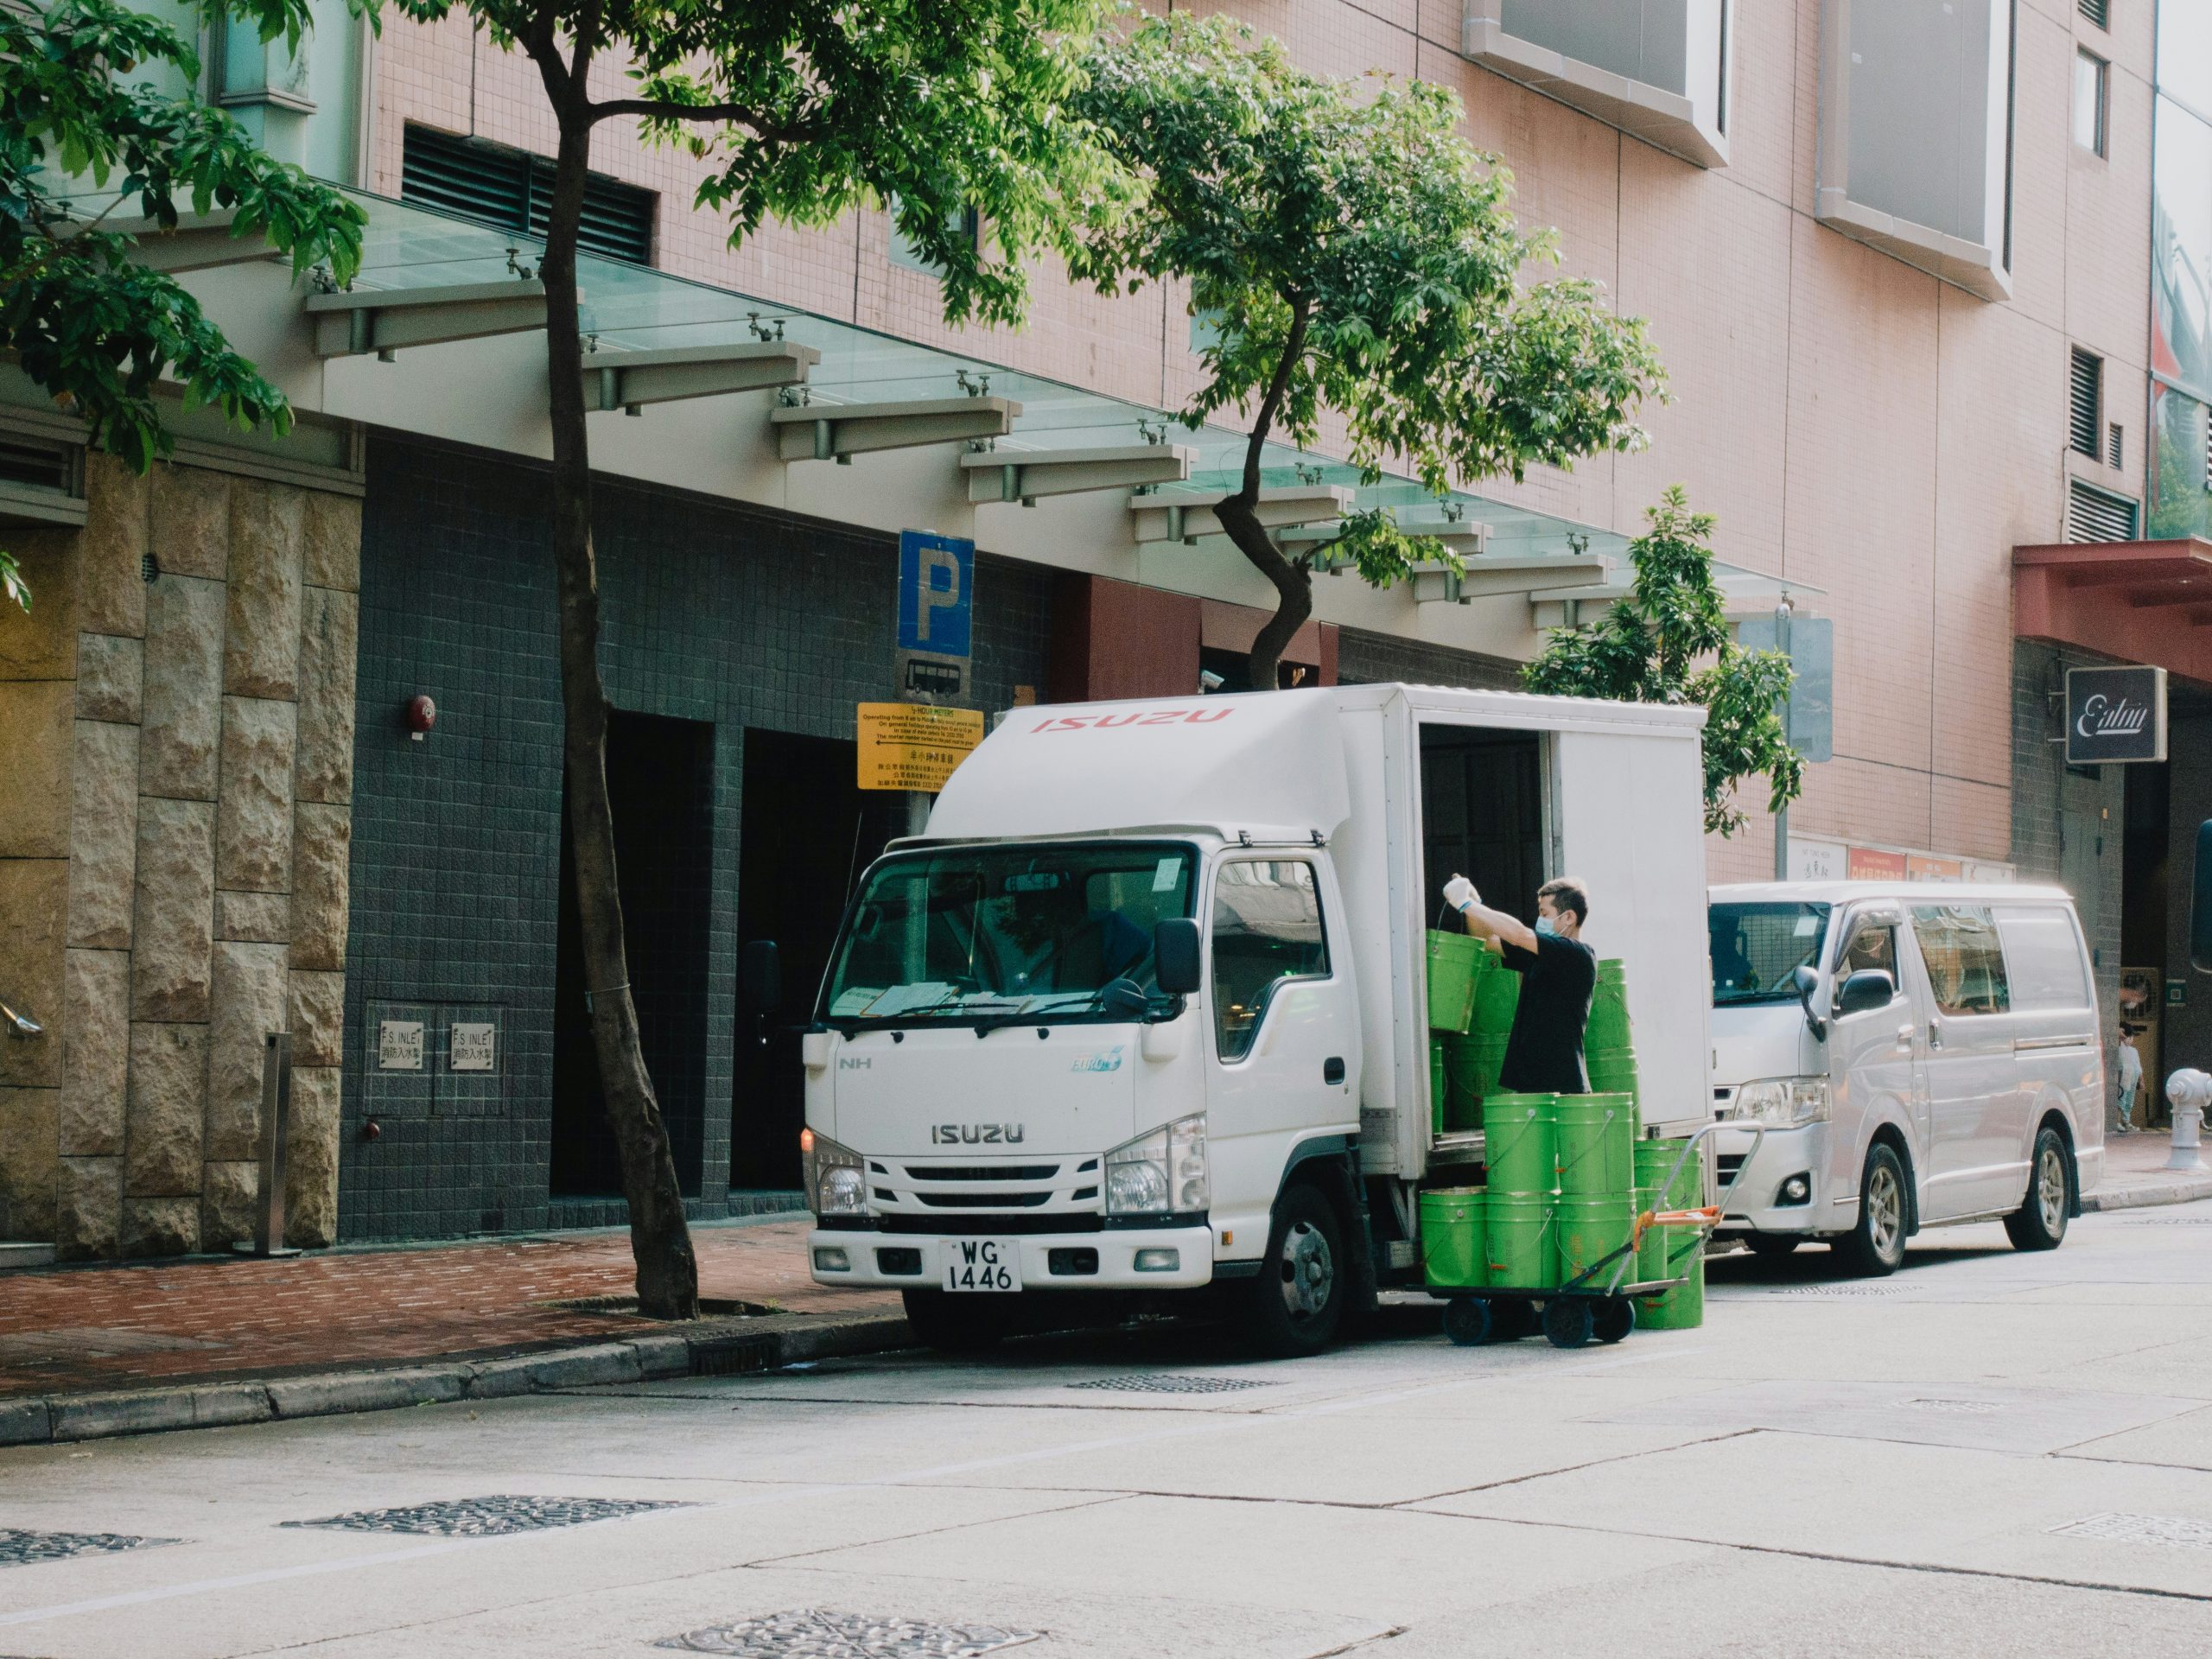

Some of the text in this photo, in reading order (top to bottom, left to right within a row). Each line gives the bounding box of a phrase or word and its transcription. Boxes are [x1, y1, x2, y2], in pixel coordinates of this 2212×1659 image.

[917, 547, 960, 641] P
[1029, 709, 1236, 734] ISUZU
[840, 1058, 872, 1070] NH
[931, 1123, 1025, 1144] ISUZU
[961, 1241, 998, 1264] WG
[950, 1266, 1012, 1289] 1446
